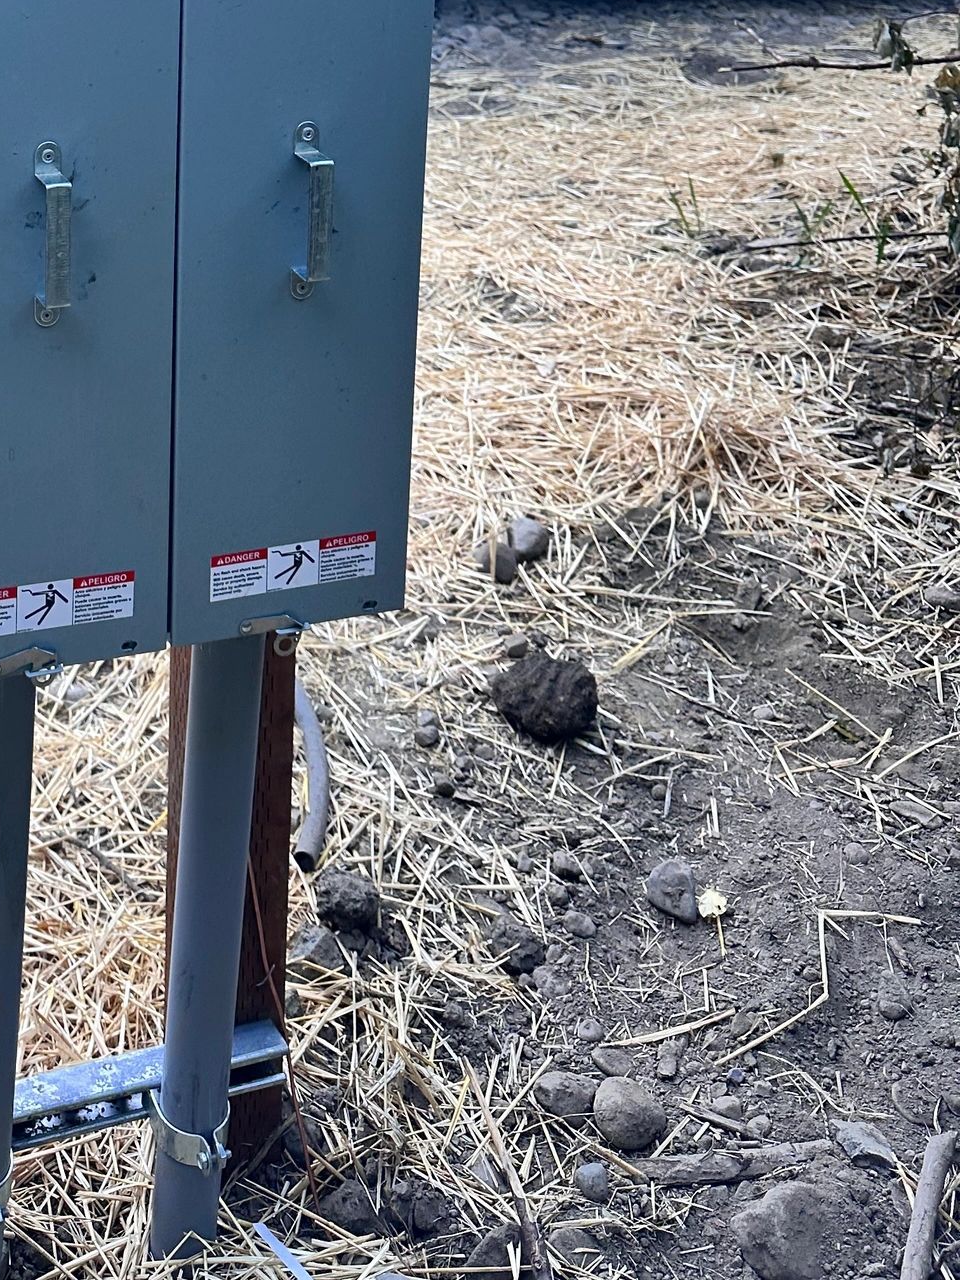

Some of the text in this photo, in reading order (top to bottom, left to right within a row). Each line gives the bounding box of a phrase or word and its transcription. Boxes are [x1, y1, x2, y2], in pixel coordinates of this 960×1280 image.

[333, 534, 368, 546] PELIGRO
[224, 551, 260, 563] DANGER
[88, 573, 127, 585] PELIGRO
